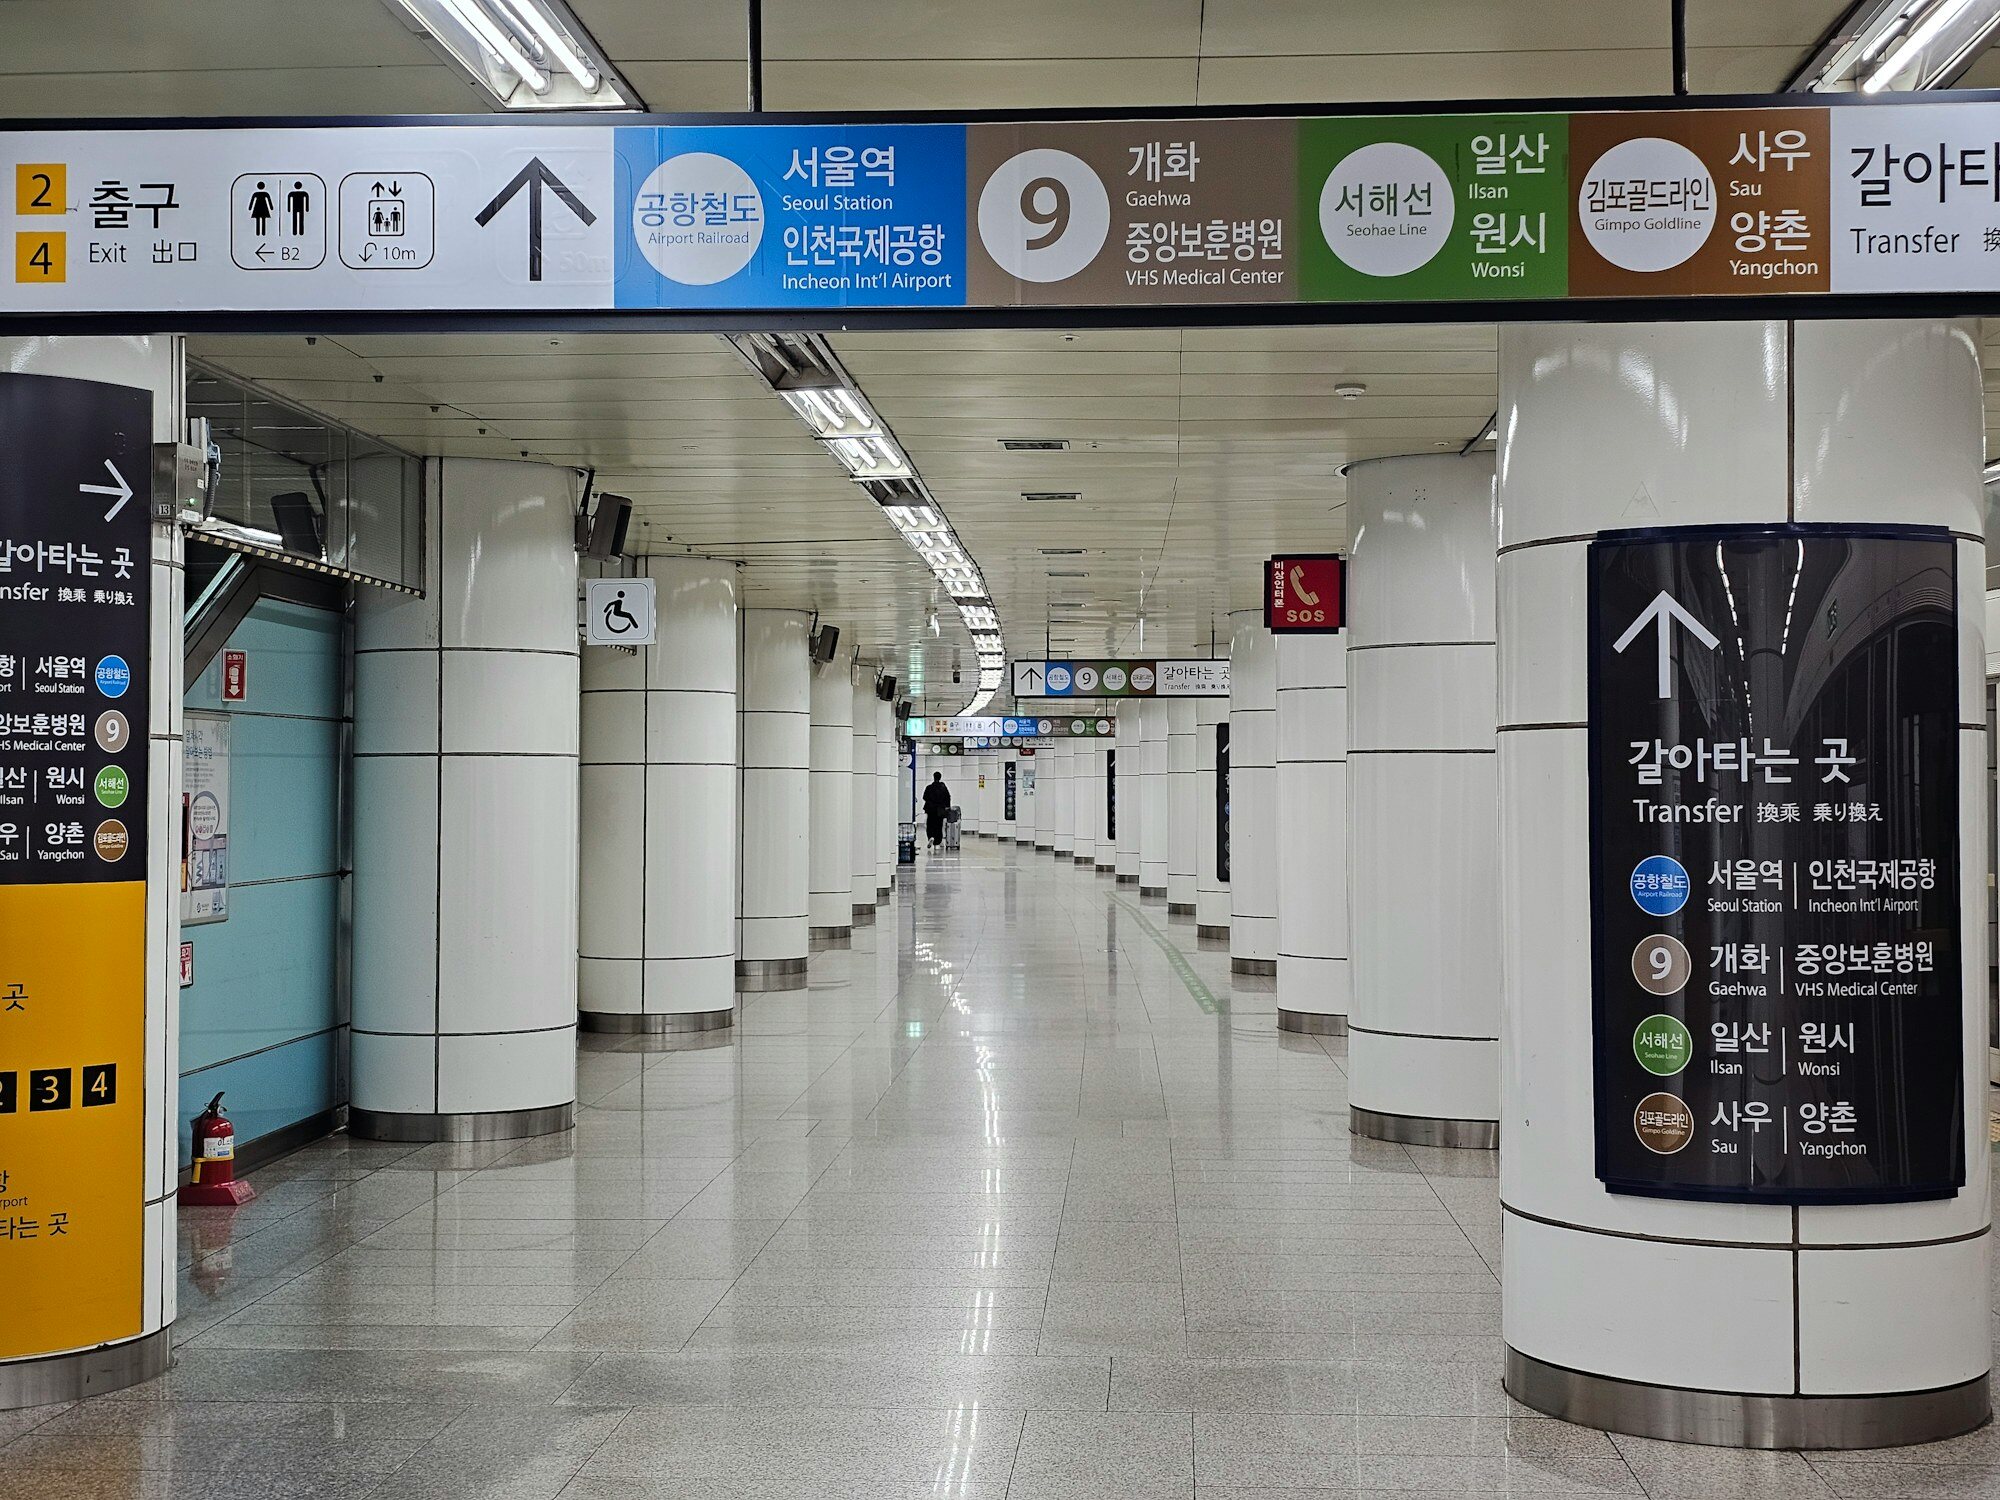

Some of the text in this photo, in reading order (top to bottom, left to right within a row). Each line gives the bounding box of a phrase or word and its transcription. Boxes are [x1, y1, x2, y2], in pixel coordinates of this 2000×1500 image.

[1471, 133, 1549, 174] 일산
[1729, 130, 1810, 171] 사우
[783, 146, 894, 187] 서울역
[1128, 141, 1200, 182] 개화
[31, 174, 51, 206] 2
[1470, 183, 1508, 199] Ilsan
[1587, 178, 1709, 212] 김포골드라인
[1730, 181, 1761, 196] Sau
[89, 181, 179, 228] 출구
[783, 195, 892, 210] Seoul Station
[1126, 190, 1190, 206] Gaehwa
[1335, 182, 1431, 217] 서해선
[637, 192, 761, 226] 공항철도
[1020, 177, 1070, 250] 9
[1347, 224, 1426, 236] Seohae Line
[1470, 213, 1545, 253] 원시
[1595, 218, 1700, 233] Gimpo Goldline
[1731, 210, 1811, 252] 양촌
[649, 232, 748, 246] Airport Railroad
[784, 224, 945, 265] 인천국제공항
[1126, 219, 1281, 263] 중앙보훈병원
[1850, 226, 1959, 253] Transfer
[30, 243, 52, 274] 4
[90, 240, 196, 263] Exit 出口
[282, 247, 299, 260] B2
[384, 247, 415, 259] 10m
[1126, 269, 1284, 285] VHS Medical Center
[1472, 262, 1524, 277] Wonsi
[1730, 259, 1818, 279] Yangchon
[783, 273, 850, 289] Incheon
[892, 273, 951, 291] Airport
[160, 505, 169, 515] 13
[111, 548, 134, 579] 곳
[1287, 610, 1324, 622] SOS
[35, 656, 85, 678] 서울역
[97, 667, 129, 679] 공항철도
[1163, 665, 1215, 681] 갈아타는
[1082, 672, 1092, 685] 9
[1164, 683, 1191, 691] Transfer
[35, 683, 57, 693] Seoul
[59, 683, 84, 693] Station
[106, 719, 119, 742] 9
[1042, 723, 1048, 732] 9
[14, 741, 52, 750] Medical
[55, 741, 85, 751] Center
[1629, 737, 1856, 784] 갈아타는 곳
[46, 767, 83, 789] 원시
[99, 778, 124, 790] 서해선
[0, 794, 84, 804] Ilsan Wonsi
[1633, 798, 1743, 823] Transfer
[1813, 802, 1883, 822] 乗り換え
[45, 822, 84, 844] 양촌
[0, 850, 84, 862] Sau Yangchon
[1633, 873, 1687, 890] 공항철도
[1708, 859, 1936, 890] 서울역 인천국제공항
[1637, 890, 1683, 899] Airport Railroad
[1708, 898, 1782, 912] Seoul Station
[1809, 898, 1857, 912] Incheon
[1883, 898, 1918, 914] Airport
[1649, 947, 1672, 979] 9
[1710, 942, 1933, 974] 개화 중앙보훈병원
[2, 984, 28, 1011] 곳
[1709, 981, 1766, 996] Gaehwa
[1795, 982, 1917, 996] VHS Medical Center
[1639, 1032, 1684, 1050] 서해선
[1711, 1022, 1854, 1053] 일산 원시
[1711, 1060, 1742, 1074] Ilsan
[1798, 1062, 1839, 1075] Wonsi
[42, 1072, 107, 1104] 3 4
[1639, 1111, 1689, 1129] 김포골드라인
[1711, 1101, 1857, 1134] 사우 양촌
[1642, 1126, 1685, 1136] Gimpo Goldline
[1712, 1139, 1737, 1153] Sau
[1799, 1141, 1866, 1159] Yangchon
[48, 1213, 68, 1235] 곳
